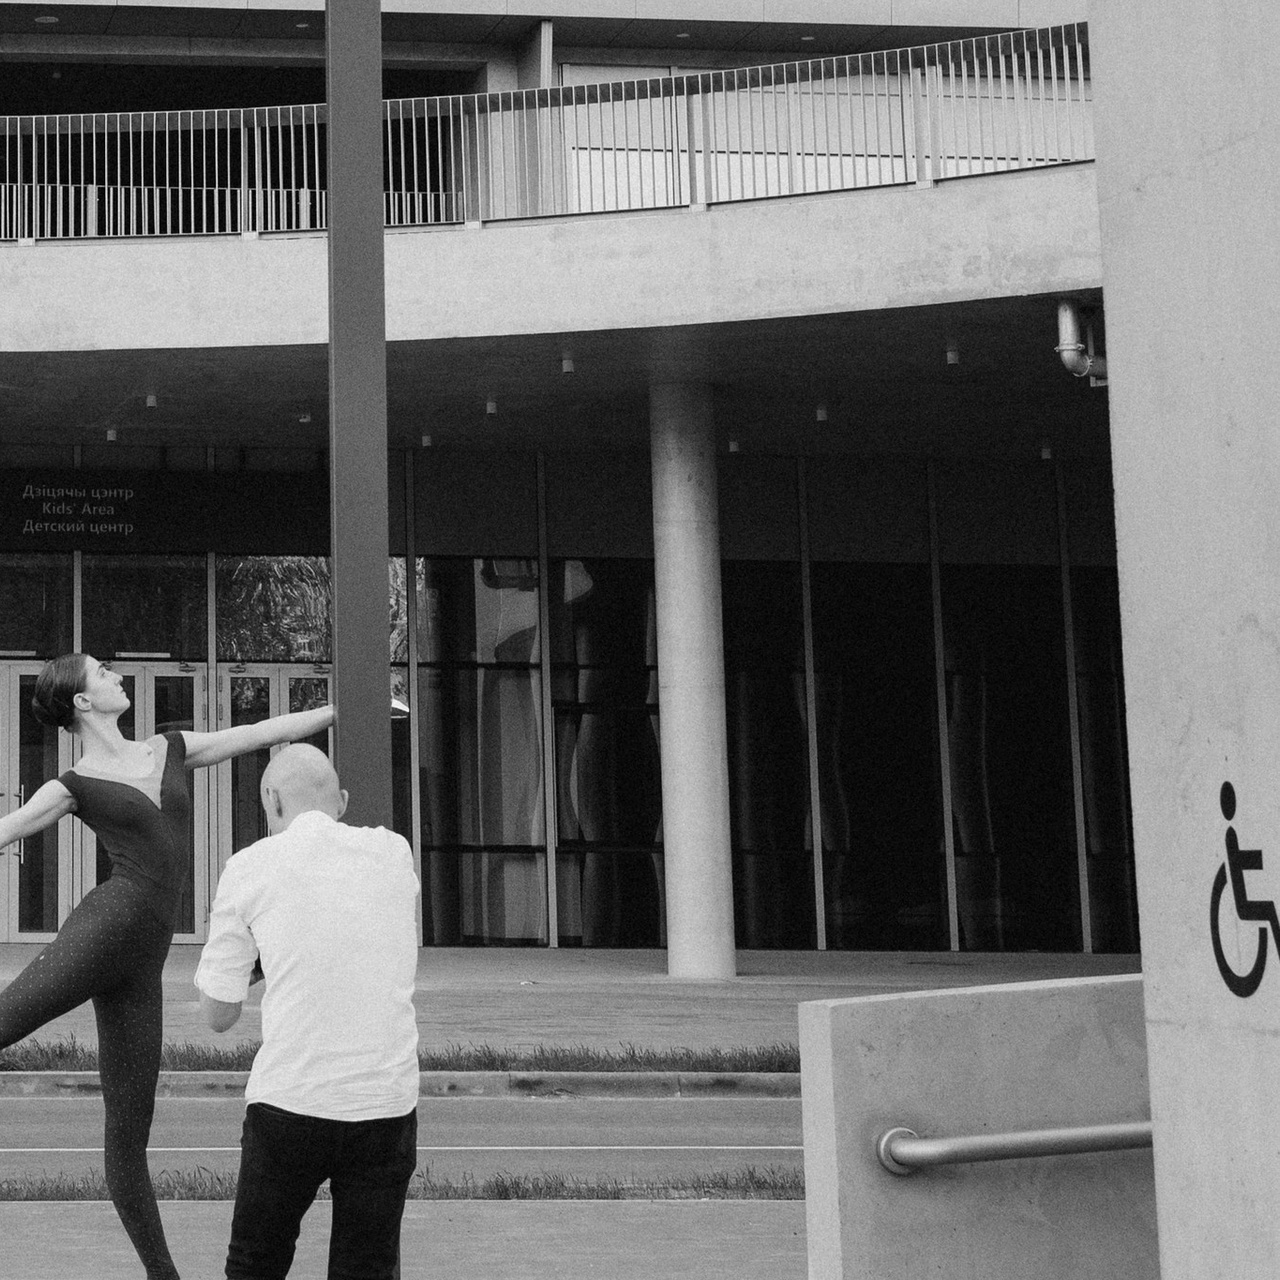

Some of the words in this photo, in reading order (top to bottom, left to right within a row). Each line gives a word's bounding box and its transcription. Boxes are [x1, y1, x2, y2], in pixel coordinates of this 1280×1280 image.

[22, 485, 86, 499] Дзіцячы
[91, 488, 134, 501] цэнтр
[81, 503, 115, 515] Area
[22, 520, 85, 534] Детский
[89, 522, 134, 536] центр
